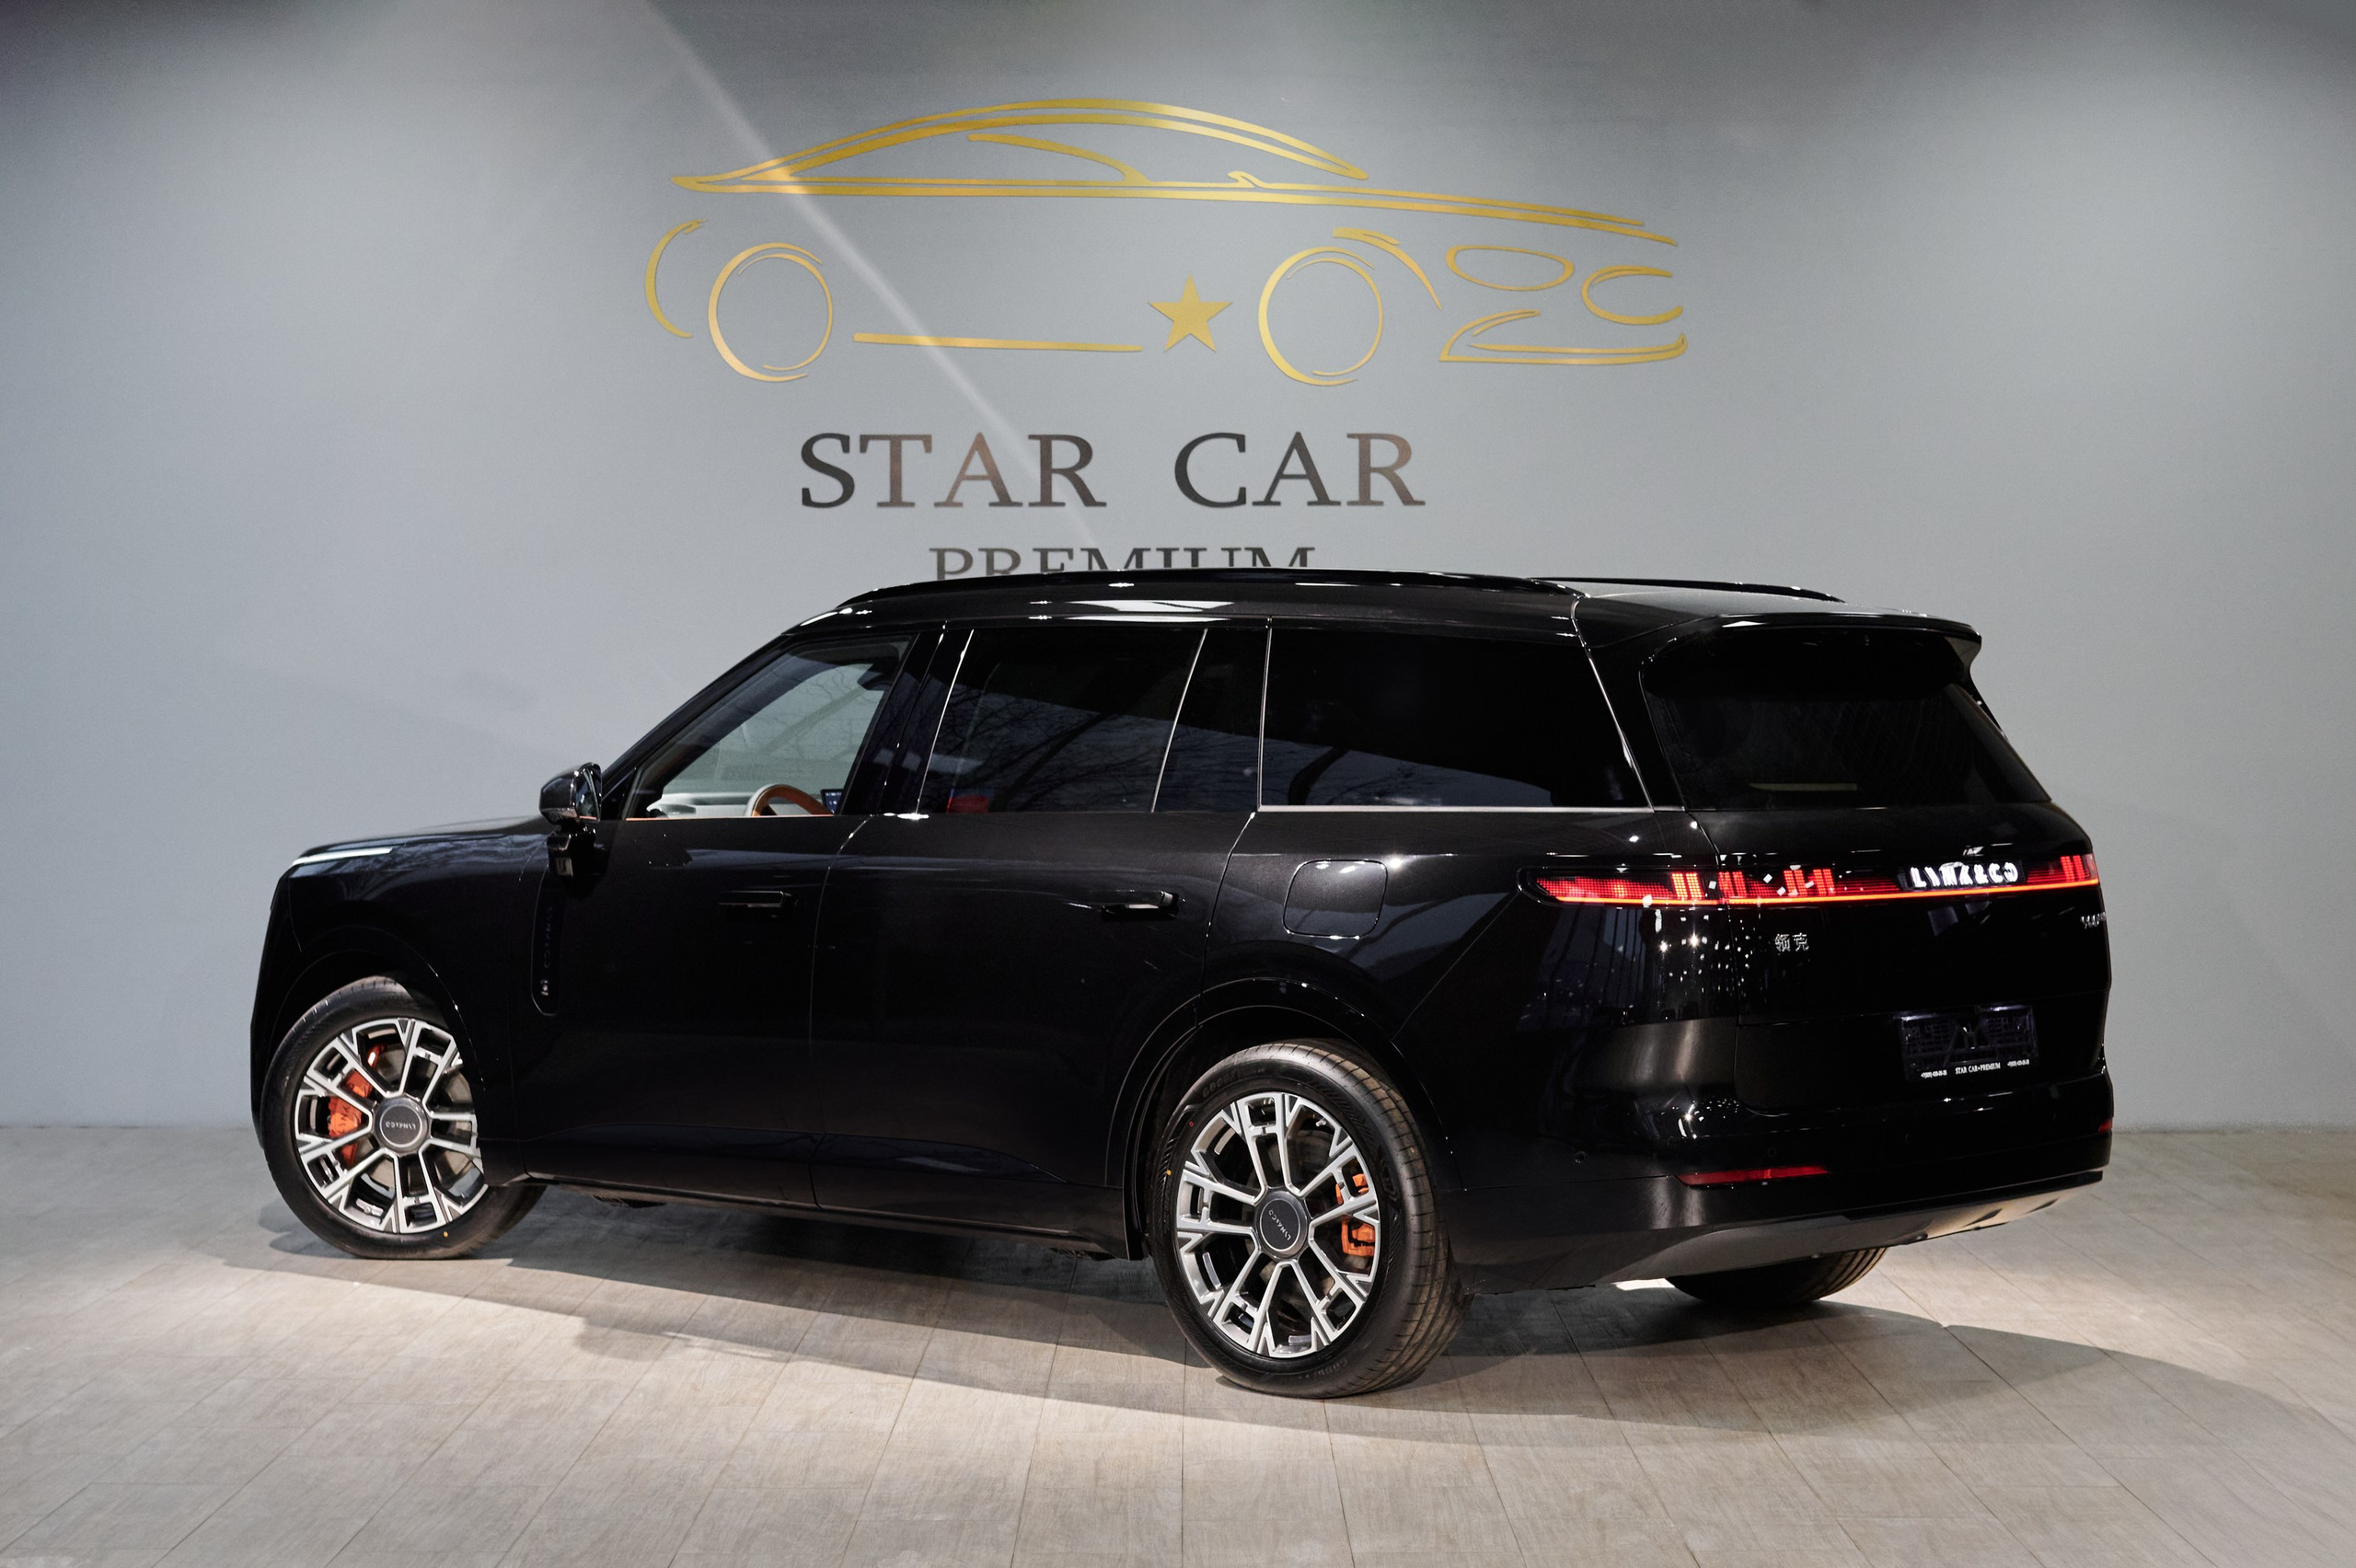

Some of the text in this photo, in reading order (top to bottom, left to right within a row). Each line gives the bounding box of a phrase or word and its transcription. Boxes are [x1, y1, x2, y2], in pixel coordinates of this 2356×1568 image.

[800, 432, 1426, 509] STAR CAR
[1774, 932, 1809, 952] 领克
